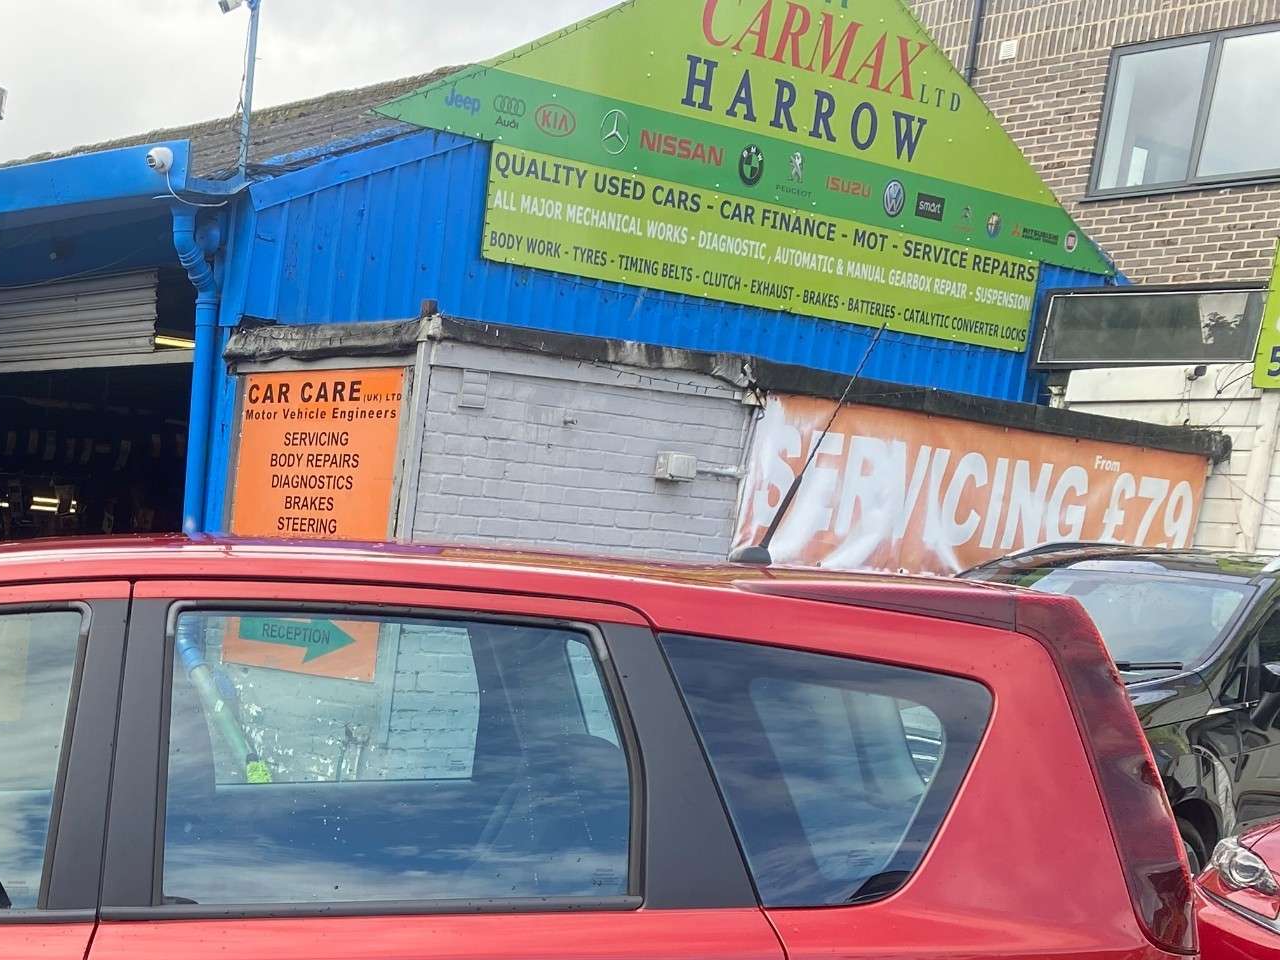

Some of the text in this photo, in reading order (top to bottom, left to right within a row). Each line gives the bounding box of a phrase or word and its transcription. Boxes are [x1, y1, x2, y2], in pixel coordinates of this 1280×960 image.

[702, 0, 961, 112] CARMAX LTD
[445, 87, 480, 116] Jeep
[681, 55, 927, 162] HARROW
[496, 115, 519, 130] Audi
[540, 108, 569, 132] KIA
[639, 129, 725, 167] NISSAN
[776, 184, 812, 198] PEUGEOT
[495, 152, 587, 188] QUALITY
[594, 172, 645, 200] USED
[652, 185, 701, 213] CARS
[720, 200, 755, 224] CAR
[761, 209, 836, 241] FINANCE
[853, 228, 888, 252] MOT
[903, 240, 968, 269] SERVICE
[972, 252, 1035, 282] REPAIRS
[918, 200, 942, 214] smart
[494, 190, 516, 211] ALL
[520, 194, 562, 220] MAJOR
[566, 204, 642, 236] MECHANICAL
[647, 219, 688, 244] WORKS
[774, 246, 835, 273] AUTOMATIC
[847, 261, 886, 284] MANUAL
[888, 269, 930, 293] GEARBOX
[934, 278, 967, 299] REPAIR
[975, 286, 1031, 311] SUSPENSION
[490, 231, 523, 251] BODY
[526, 237, 561, 258] WORK
[573, 246, 607, 267] TYRES
[618, 254, 658, 276] TIMING
[662, 261, 693, 282] BELTS
[703, 270, 741, 291] CLUTCH
[750, 279, 794, 301] EXHAUST
[802, 289, 839, 309] BRAKES
[848, 297, 896, 319] BATTERIES
[903, 308, 950, 329] CATALYTIC
[952, 317, 999, 338] CONVERTER
[1000, 326, 1026, 342] LOCKS
[248, 380, 402, 404] CAR CARE (UK) LTD
[245, 407, 397, 422] Motor Vehicle Engineers
[284, 431, 349, 447] SERVICING
[270, 453, 360, 469] BODY REPAIRS
[1094, 455, 1120, 472] From
[271, 475, 353, 490] DIAGNOSTICS
[756, 416, 1193, 551] SERVICING £79
[284, 496, 334, 511] BRAKES
[277, 517, 337, 534] STEERING
[262, 623, 331, 645] RECEPTION
